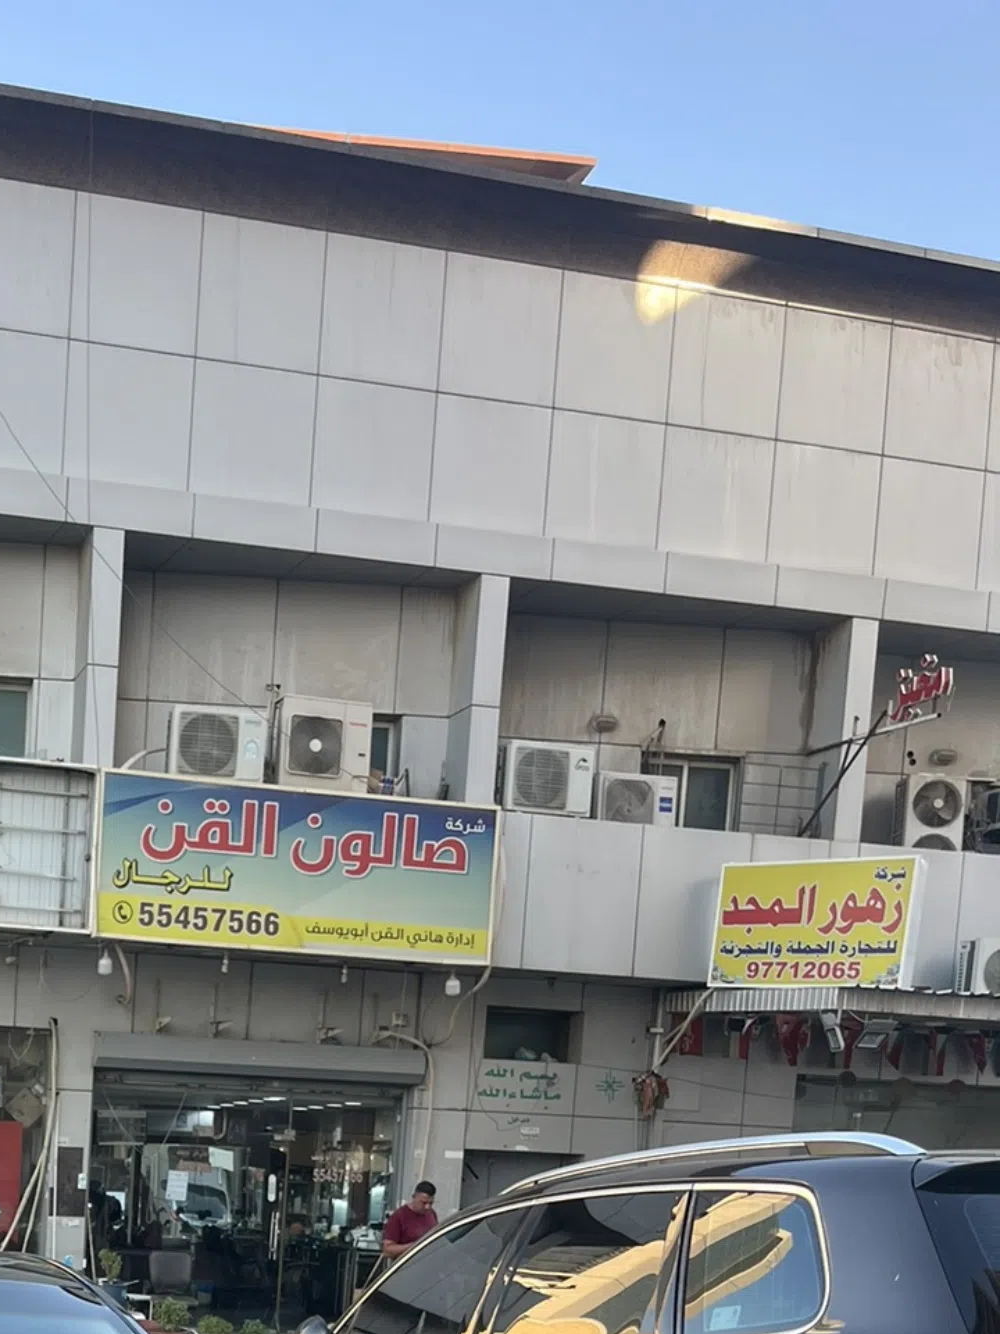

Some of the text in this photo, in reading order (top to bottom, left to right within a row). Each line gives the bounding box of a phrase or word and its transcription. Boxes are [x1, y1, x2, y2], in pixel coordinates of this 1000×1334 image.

[445, 817, 486, 834] شركة
[140, 799, 469, 878] صالون القن
[112, 857, 233, 894] للرجال
[875, 867, 906, 882] شركة
[721, 883, 903, 935] زهور المجد
[138, 902, 280, 936] 55457566
[370, 927, 404, 943] القن
[406, 930, 444, 949] هاني
[446, 933, 475, 950] إدارة
[719, 941, 897, 958] للتجارة الجملة والتجزئة
[746, 961, 861, 979] 97712065
